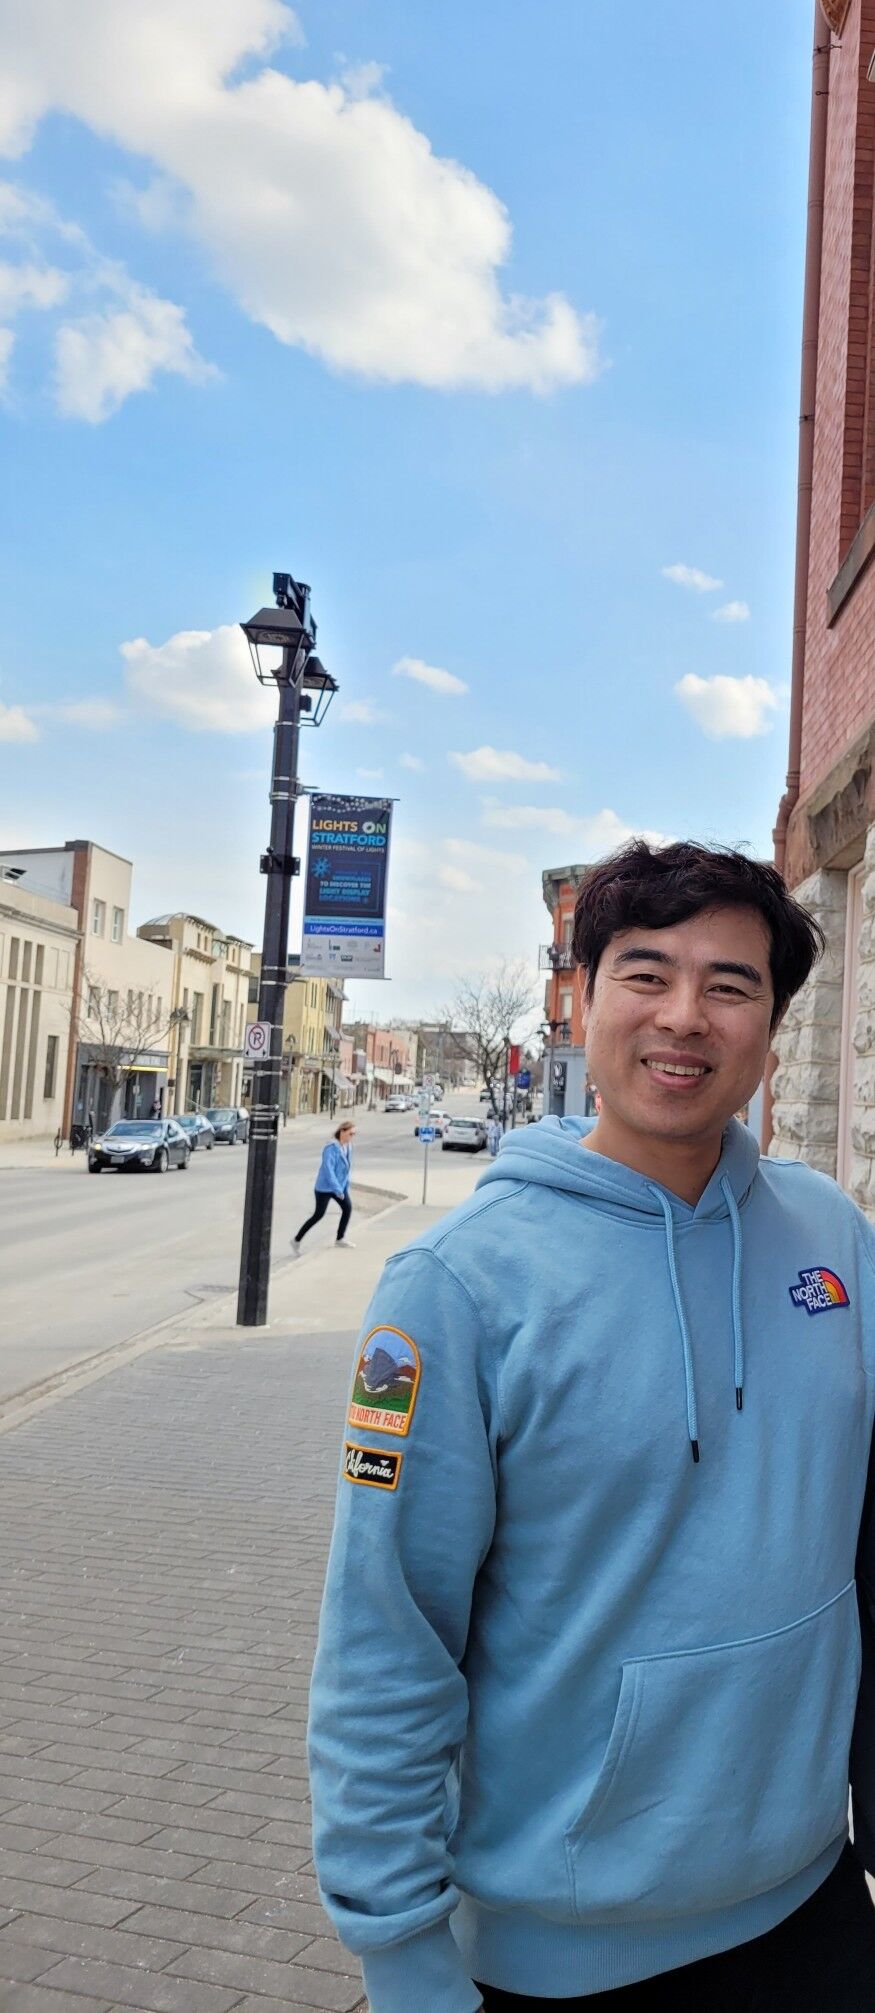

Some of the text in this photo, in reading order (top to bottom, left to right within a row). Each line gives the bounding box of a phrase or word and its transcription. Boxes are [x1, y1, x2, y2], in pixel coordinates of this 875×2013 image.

[312, 820, 386, 834] LIGHTS ON
[311, 832, 386, 846] STRATFORD
[329, 880, 358, 888] DISCOVER
[310, 925, 378, 935] LightsOnStratford.ca
[802, 1270, 823, 1285] THE
[792, 1282, 828, 1302] NORTH
[806, 1293, 832, 1310] FACE
[356, 1407, 381, 1425] NORTH
[384, 1411, 407, 1429] FACE
[345, 1449, 394, 1477] Clifornia
